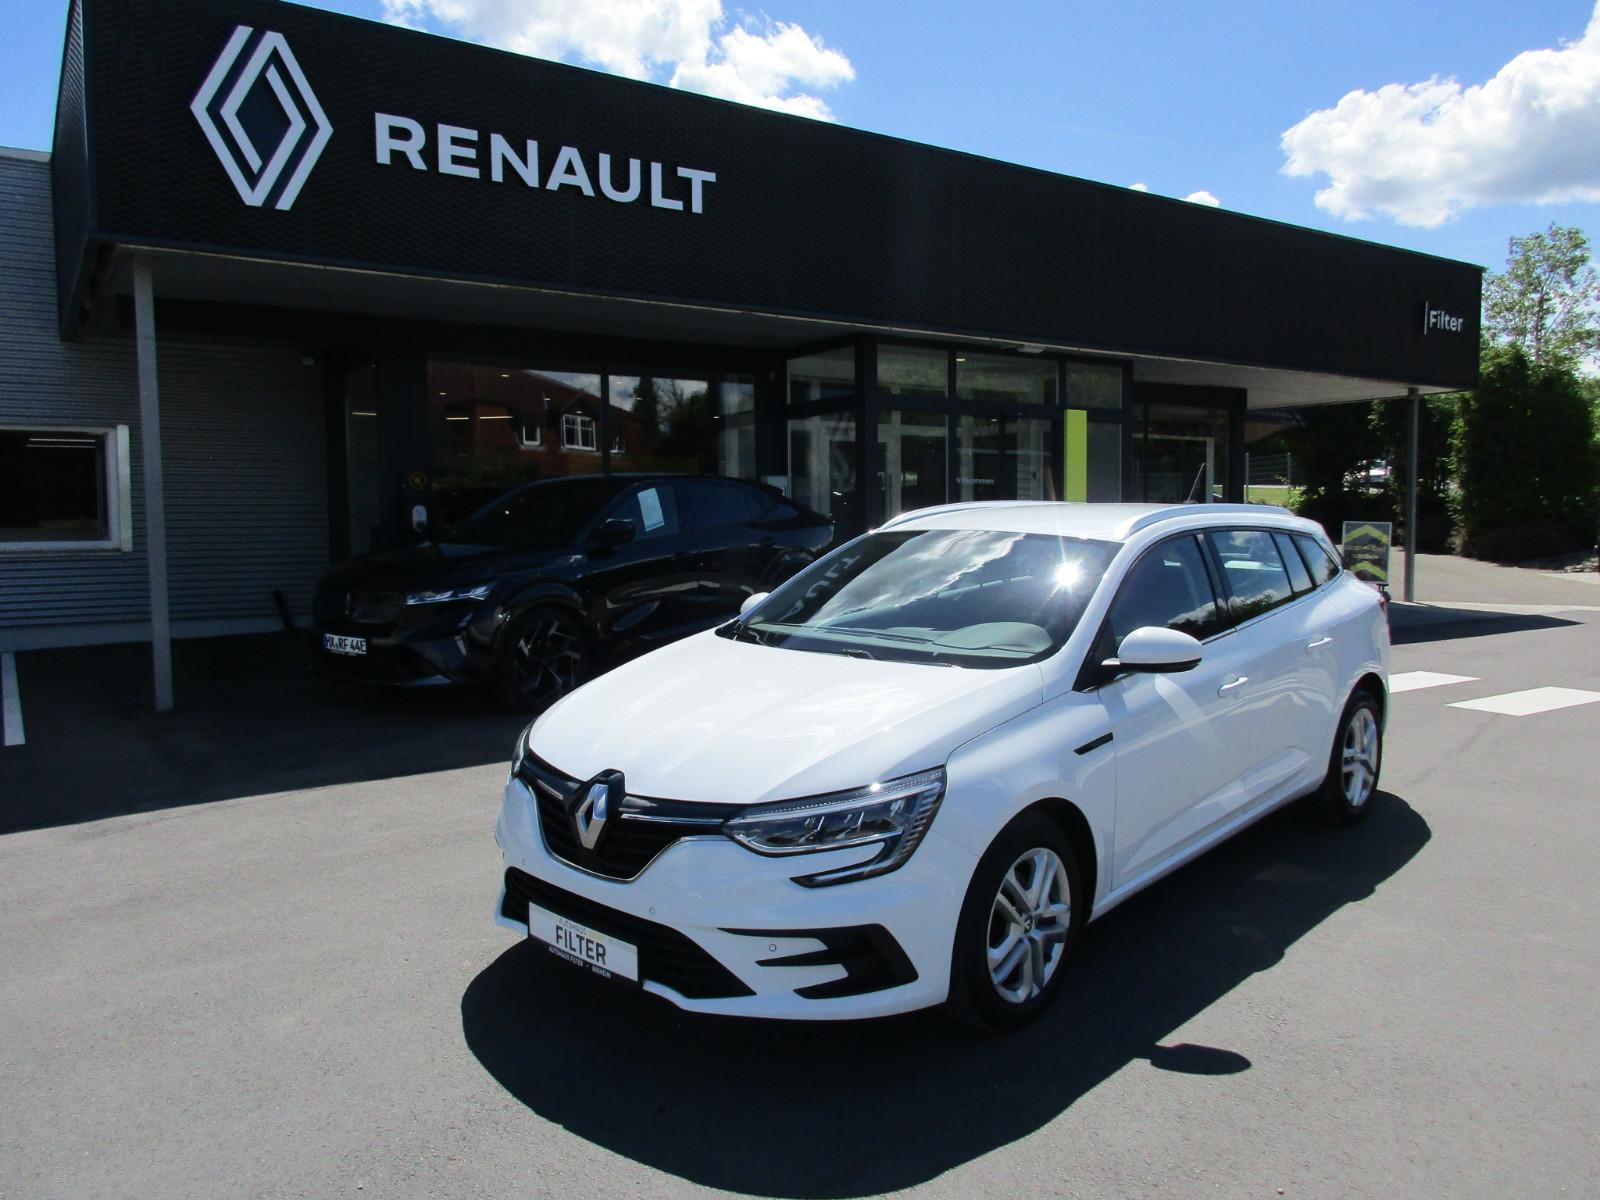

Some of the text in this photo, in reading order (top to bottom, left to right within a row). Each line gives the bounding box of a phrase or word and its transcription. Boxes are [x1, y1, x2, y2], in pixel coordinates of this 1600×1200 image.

[374, 112, 717, 214] RENAULT
[1429, 310, 1464, 332] Filter
[555, 924, 607, 965] FILTER
